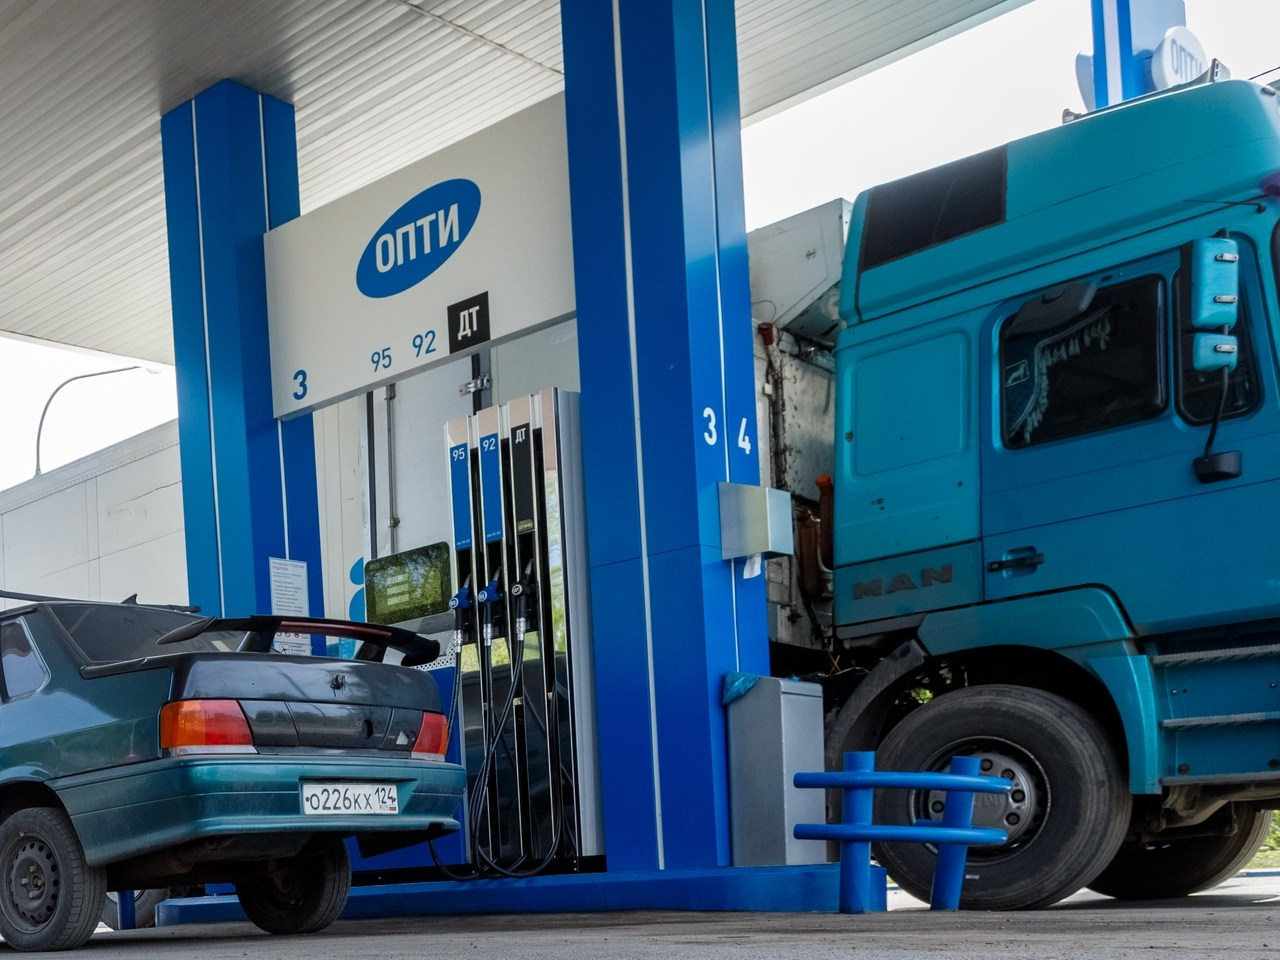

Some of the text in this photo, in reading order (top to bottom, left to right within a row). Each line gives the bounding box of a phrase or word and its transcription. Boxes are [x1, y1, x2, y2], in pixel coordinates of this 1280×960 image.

[375, 203, 460, 273] ОПТИ
[371, 305, 480, 372] 95 92 ДТ
[292, 369, 308, 400] 3
[515, 427, 527, 444] ДТ
[703, 407, 717, 446] 3
[738, 417, 751, 455] 4
[452, 447, 465, 462] 95
[483, 437, 496, 452] 92
[853, 563, 952, 600] MAN
[374, 787, 397, 805] 124
